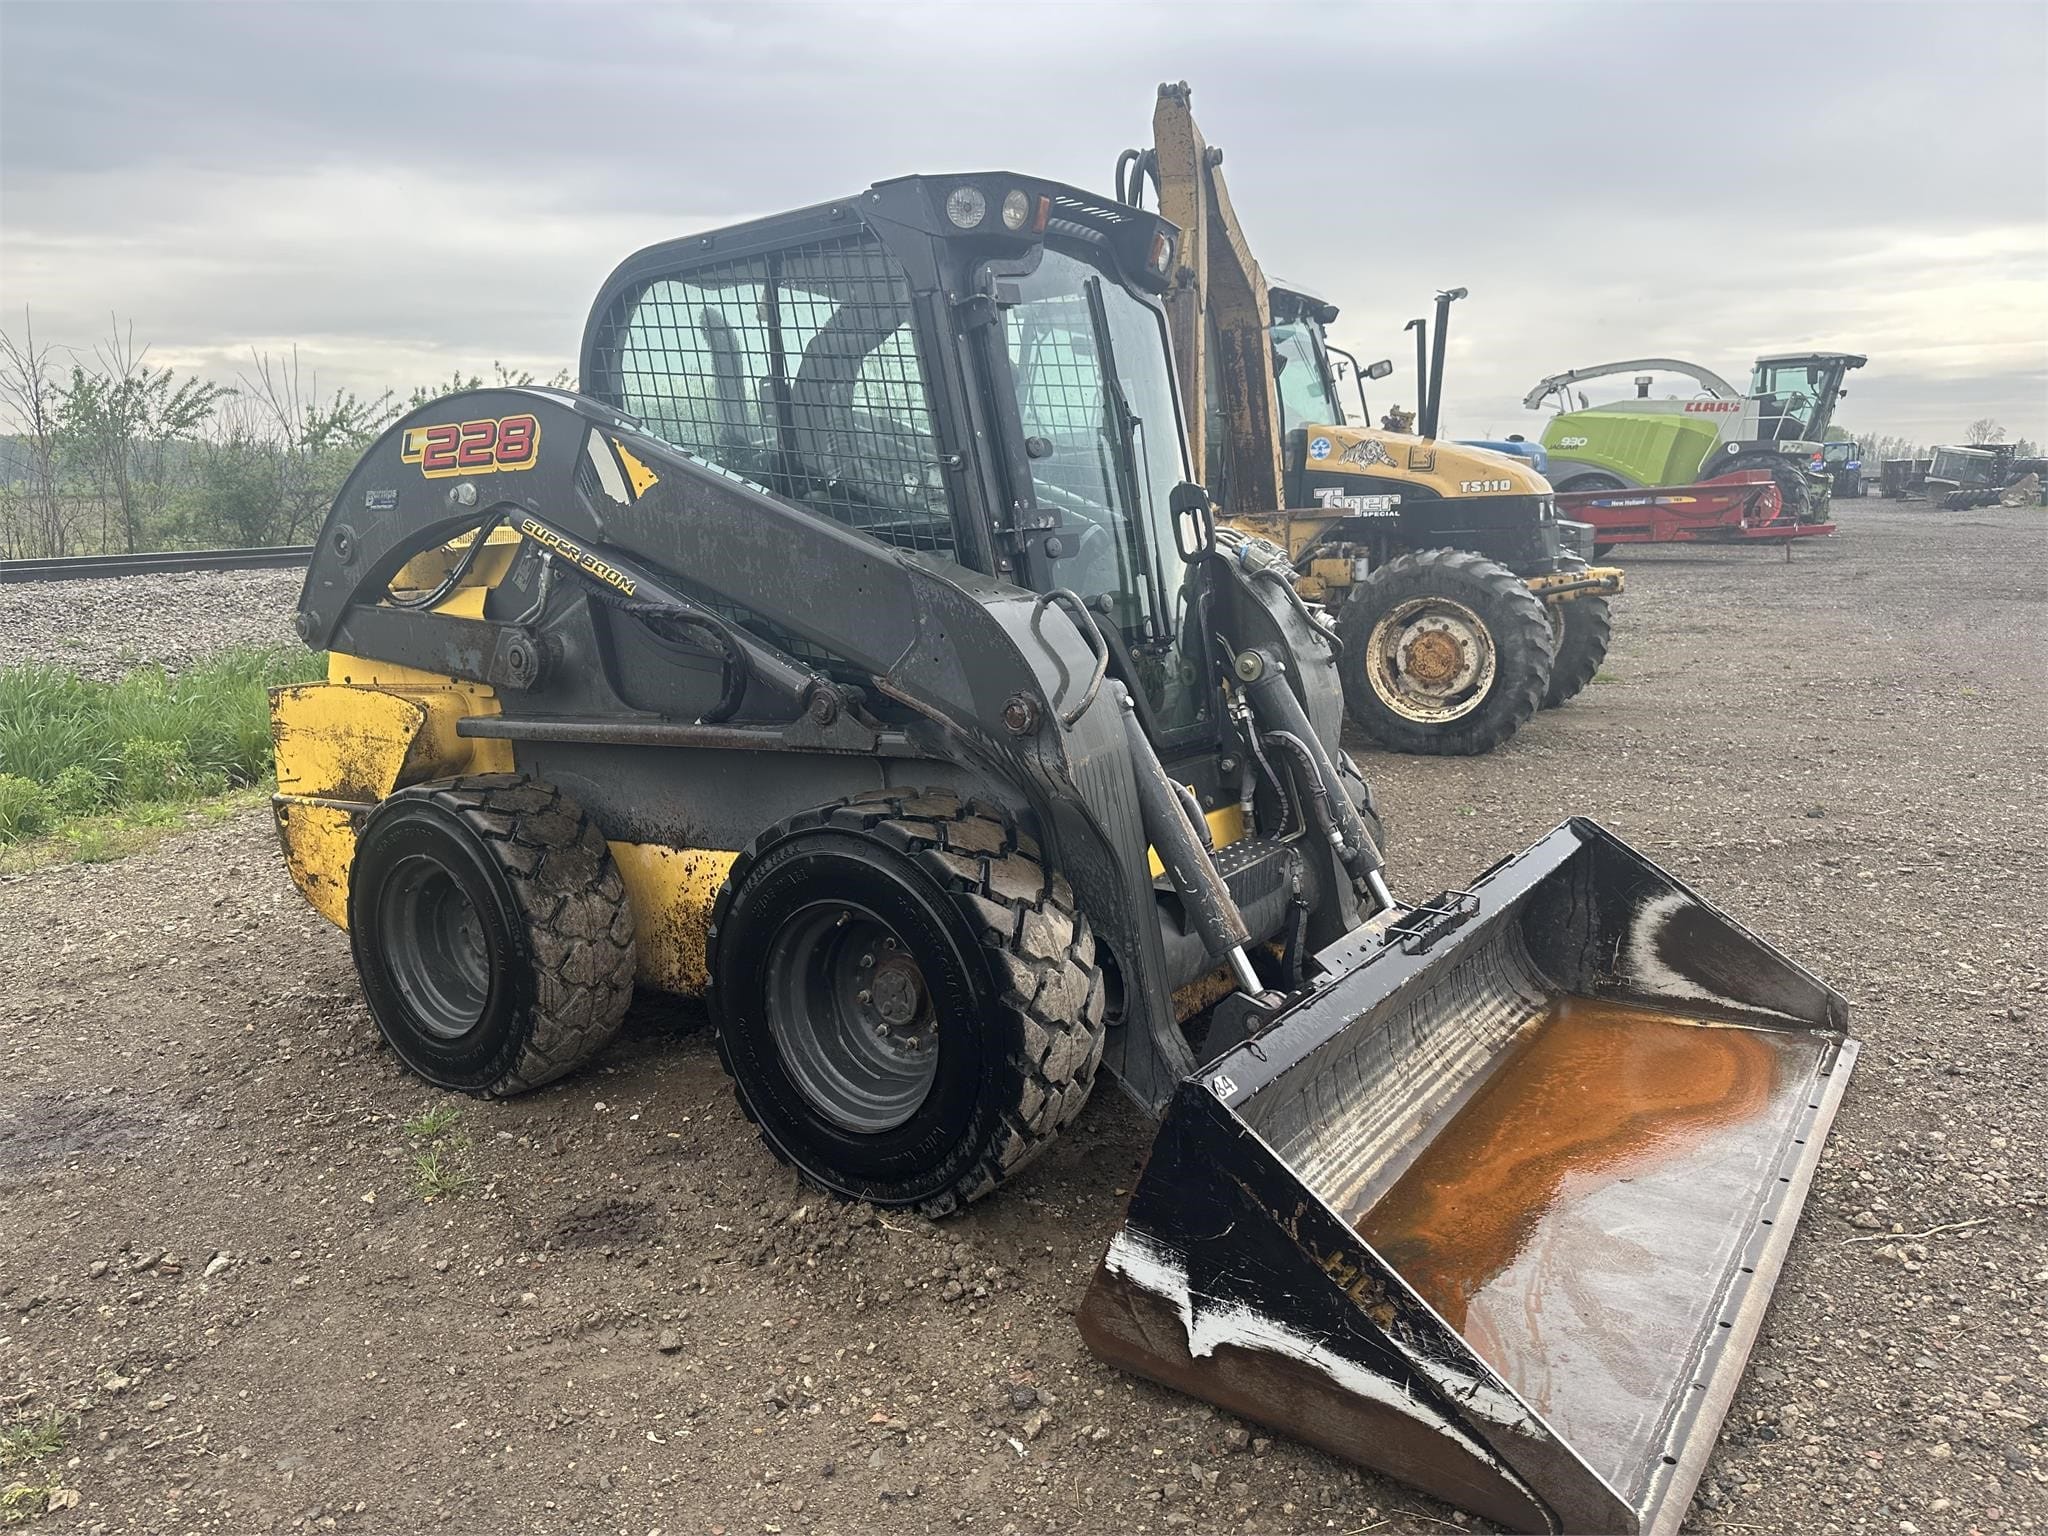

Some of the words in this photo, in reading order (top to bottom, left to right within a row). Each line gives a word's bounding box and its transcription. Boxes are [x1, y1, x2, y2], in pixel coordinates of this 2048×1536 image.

[1684, 402, 1741, 413] CLAAS
[401, 413, 541, 479] L228
[1560, 436, 1588, 447] 930
[1729, 443, 1738, 452] 40
[1460, 480, 1511, 493] TS110
[1313, 487, 1402, 518] Tiger
[1625, 498, 1646, 506] Holland
[521, 519, 581, 563] SUPER
[580, 554, 637, 596] BOOM
